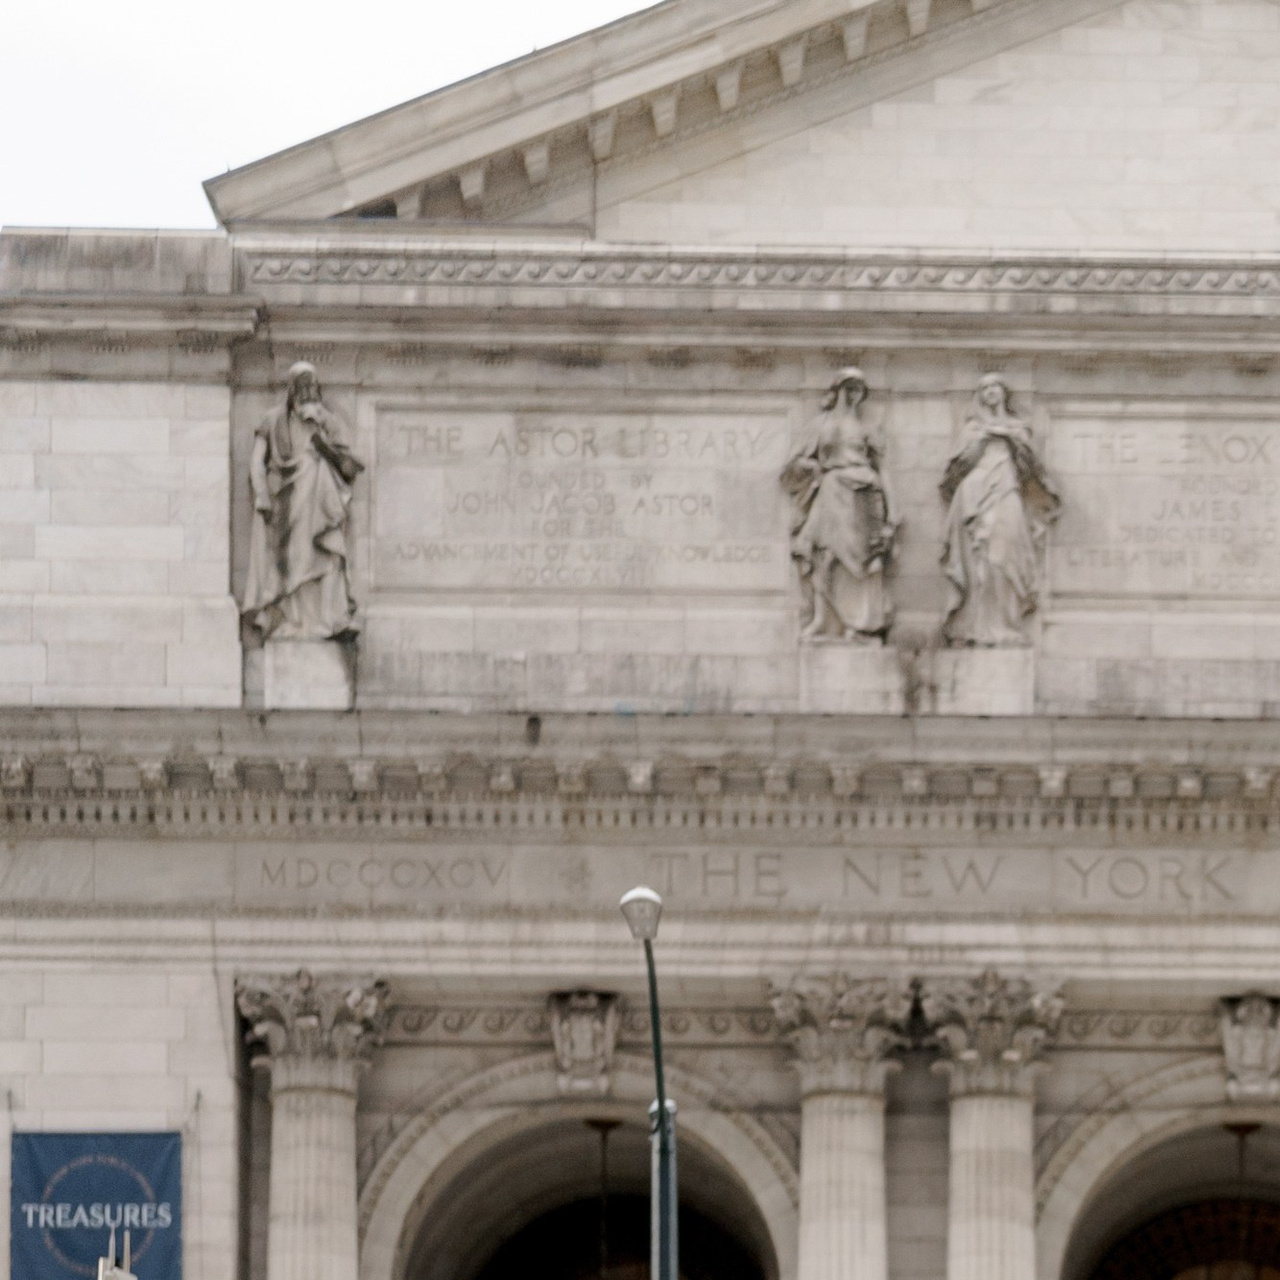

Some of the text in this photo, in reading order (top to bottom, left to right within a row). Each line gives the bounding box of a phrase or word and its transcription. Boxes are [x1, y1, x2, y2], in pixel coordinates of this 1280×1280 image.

[399, 427, 764, 459] THE ASTOR LIBRARY
[1074, 434, 1139, 463] THE
[447, 493, 714, 516] JOHN JACOB ASTOR
[1152, 500, 1242, 522] JAMES
[261, 857, 508, 889] MDCCCXCV
[650, 851, 788, 898] THE
[841, 853, 1004, 898] NEW
[1064, 854, 1235, 901] YORK
[21, 1202, 172, 1229] TREASURES
